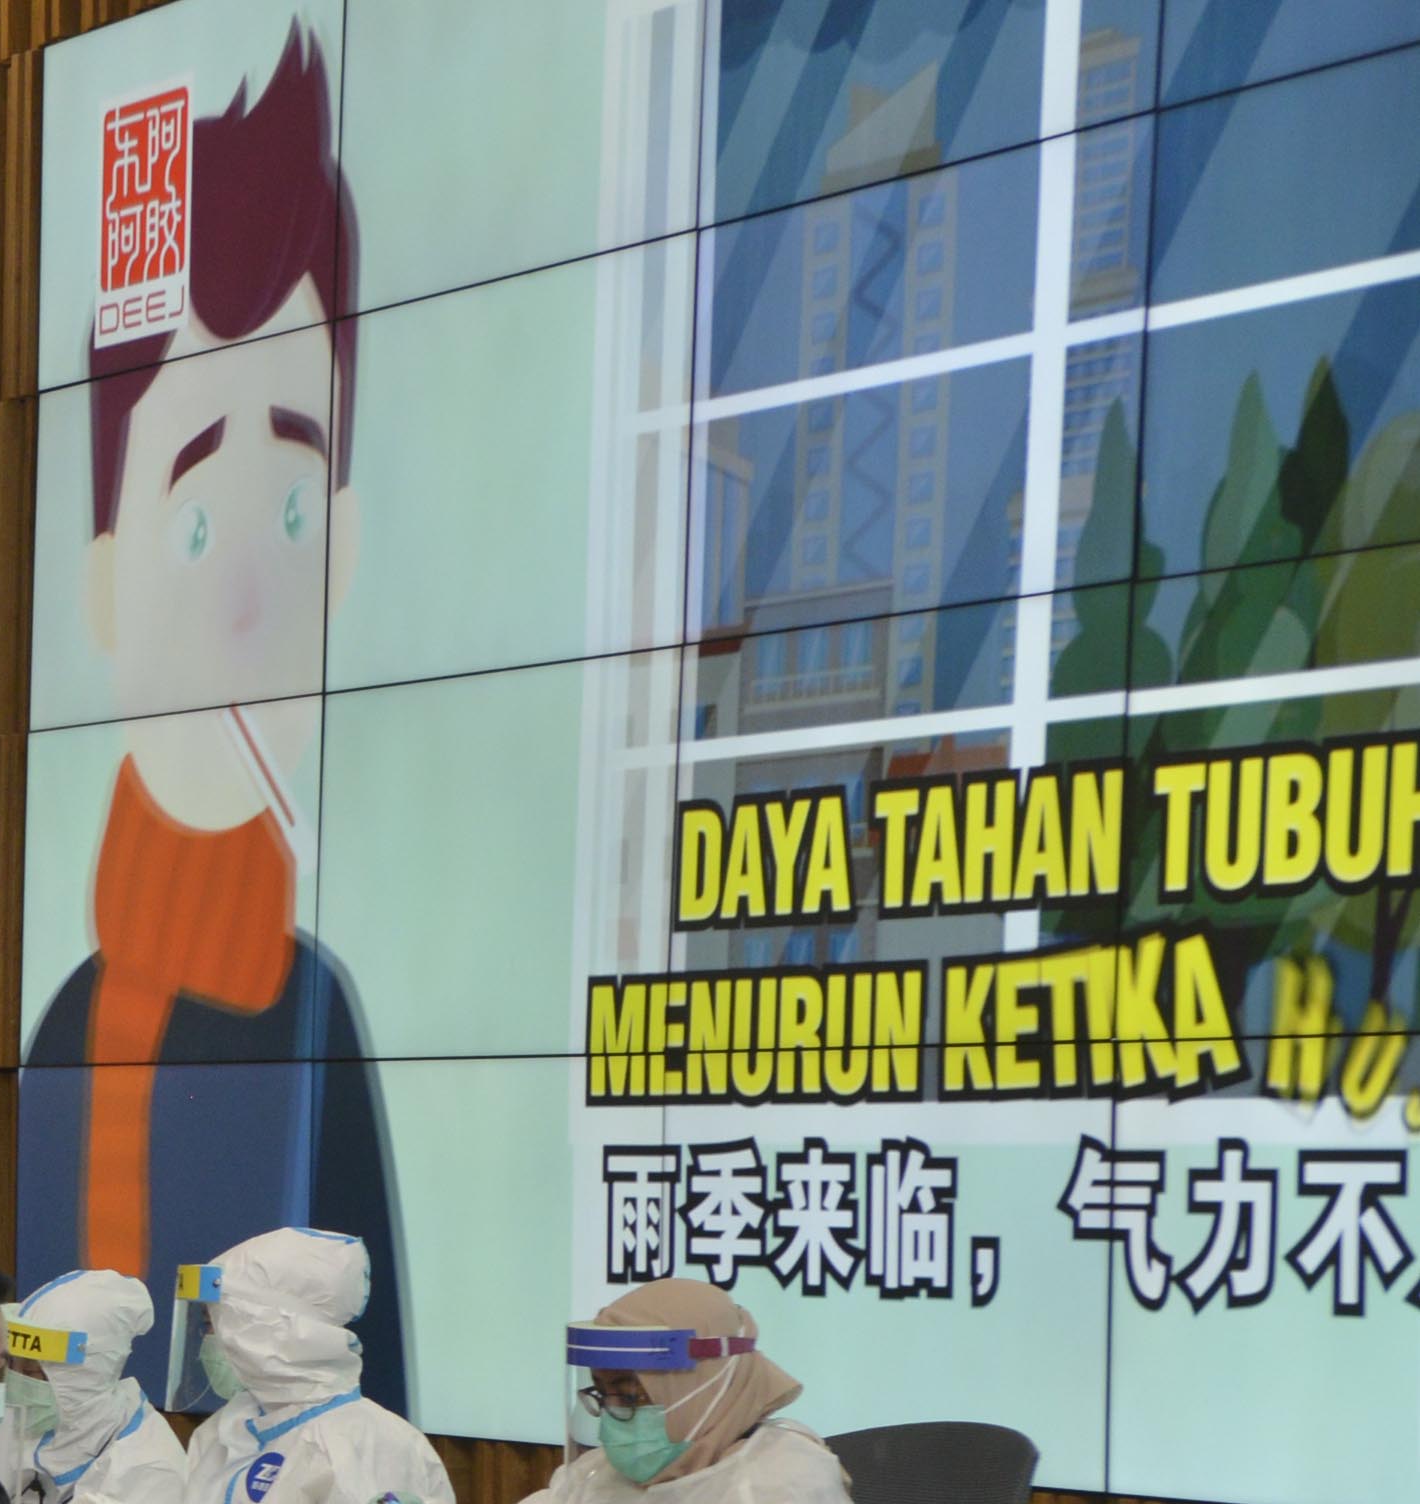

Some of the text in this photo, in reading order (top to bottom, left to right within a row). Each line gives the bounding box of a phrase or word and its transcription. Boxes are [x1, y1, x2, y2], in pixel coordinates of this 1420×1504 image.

[98, 284, 186, 336] DEEJ
[677, 740, 1420, 924] DAYA TAHAN TUBUH
[588, 931, 1420, 1132] MENURUN KETIKA HU
